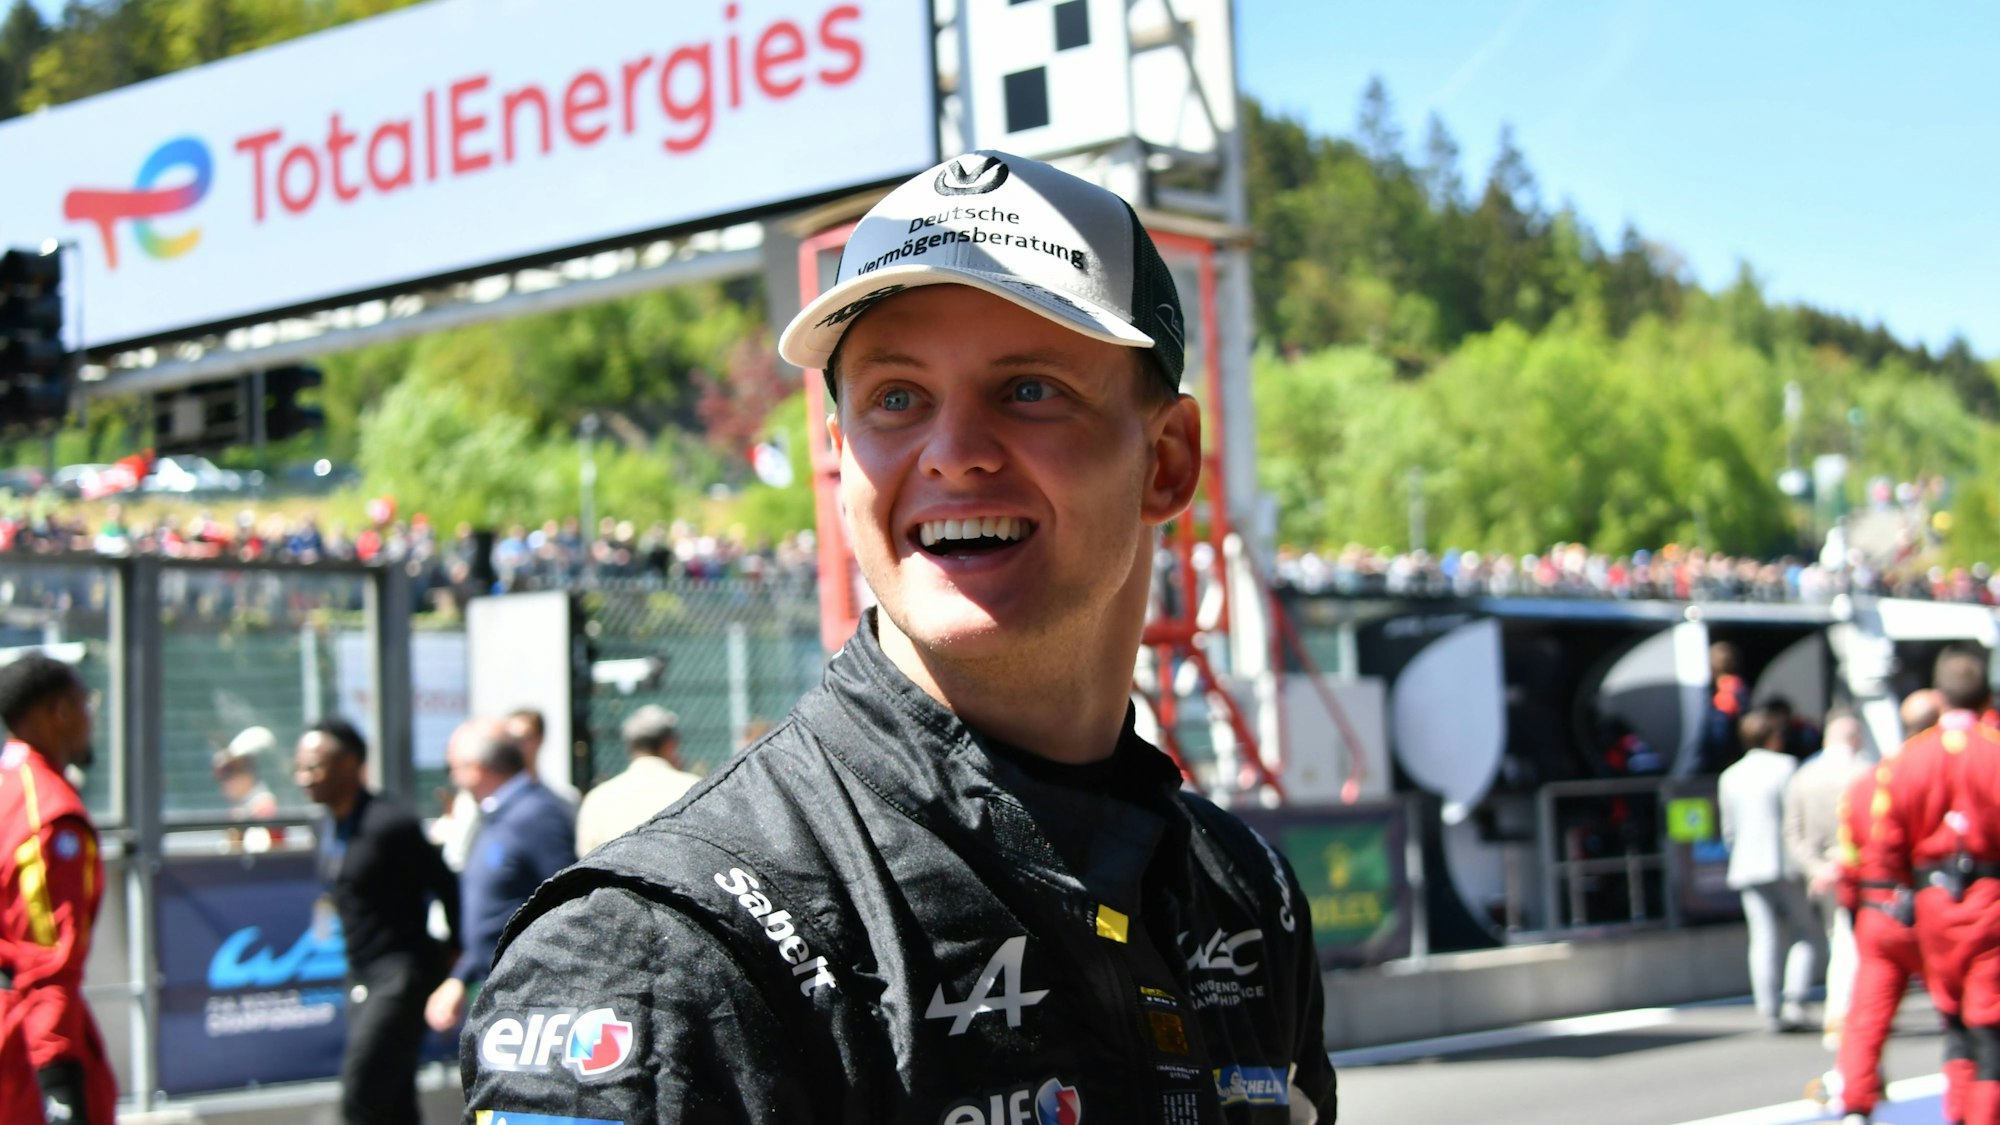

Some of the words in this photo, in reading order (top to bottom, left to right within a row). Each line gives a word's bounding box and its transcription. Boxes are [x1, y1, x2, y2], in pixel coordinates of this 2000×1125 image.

[234, 3, 865, 223] TotalEnergies
[908, 206, 1020, 234] Deutsche
[713, 867, 837, 998] Sabelt
[483, 1014, 572, 1066] elf
[943, 1089, 1032, 1125] elf
